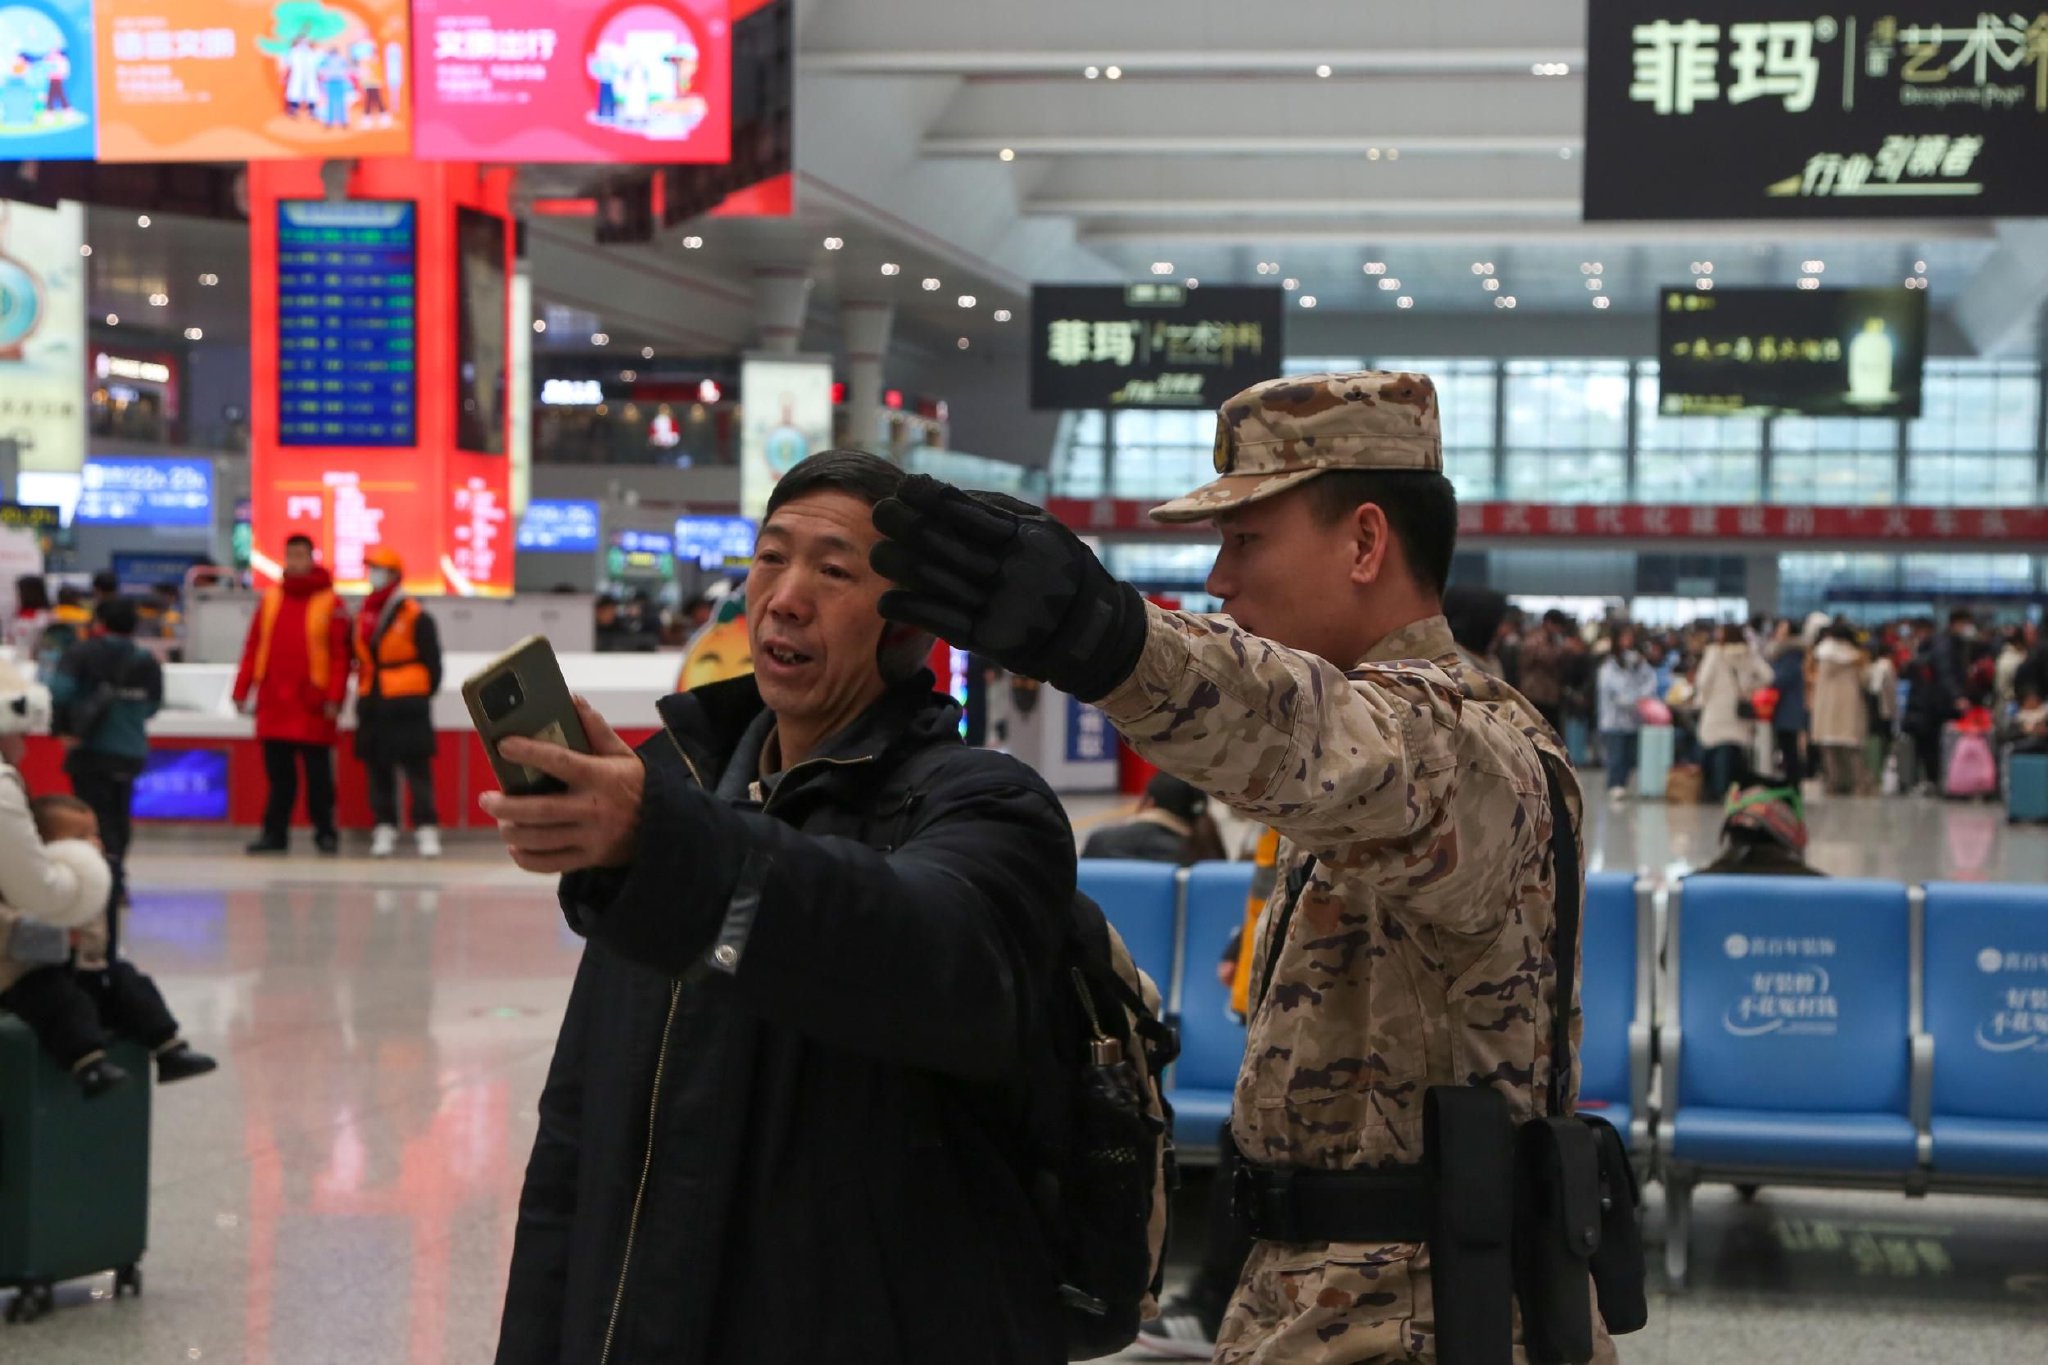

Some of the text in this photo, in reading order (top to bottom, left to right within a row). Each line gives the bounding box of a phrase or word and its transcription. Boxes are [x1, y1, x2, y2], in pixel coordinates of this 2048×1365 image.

[1629, 19, 1820, 114] 菲玛
[1801, 134, 1983, 197] 行业引领者
[1048, 319, 1135, 366] 菲玛
